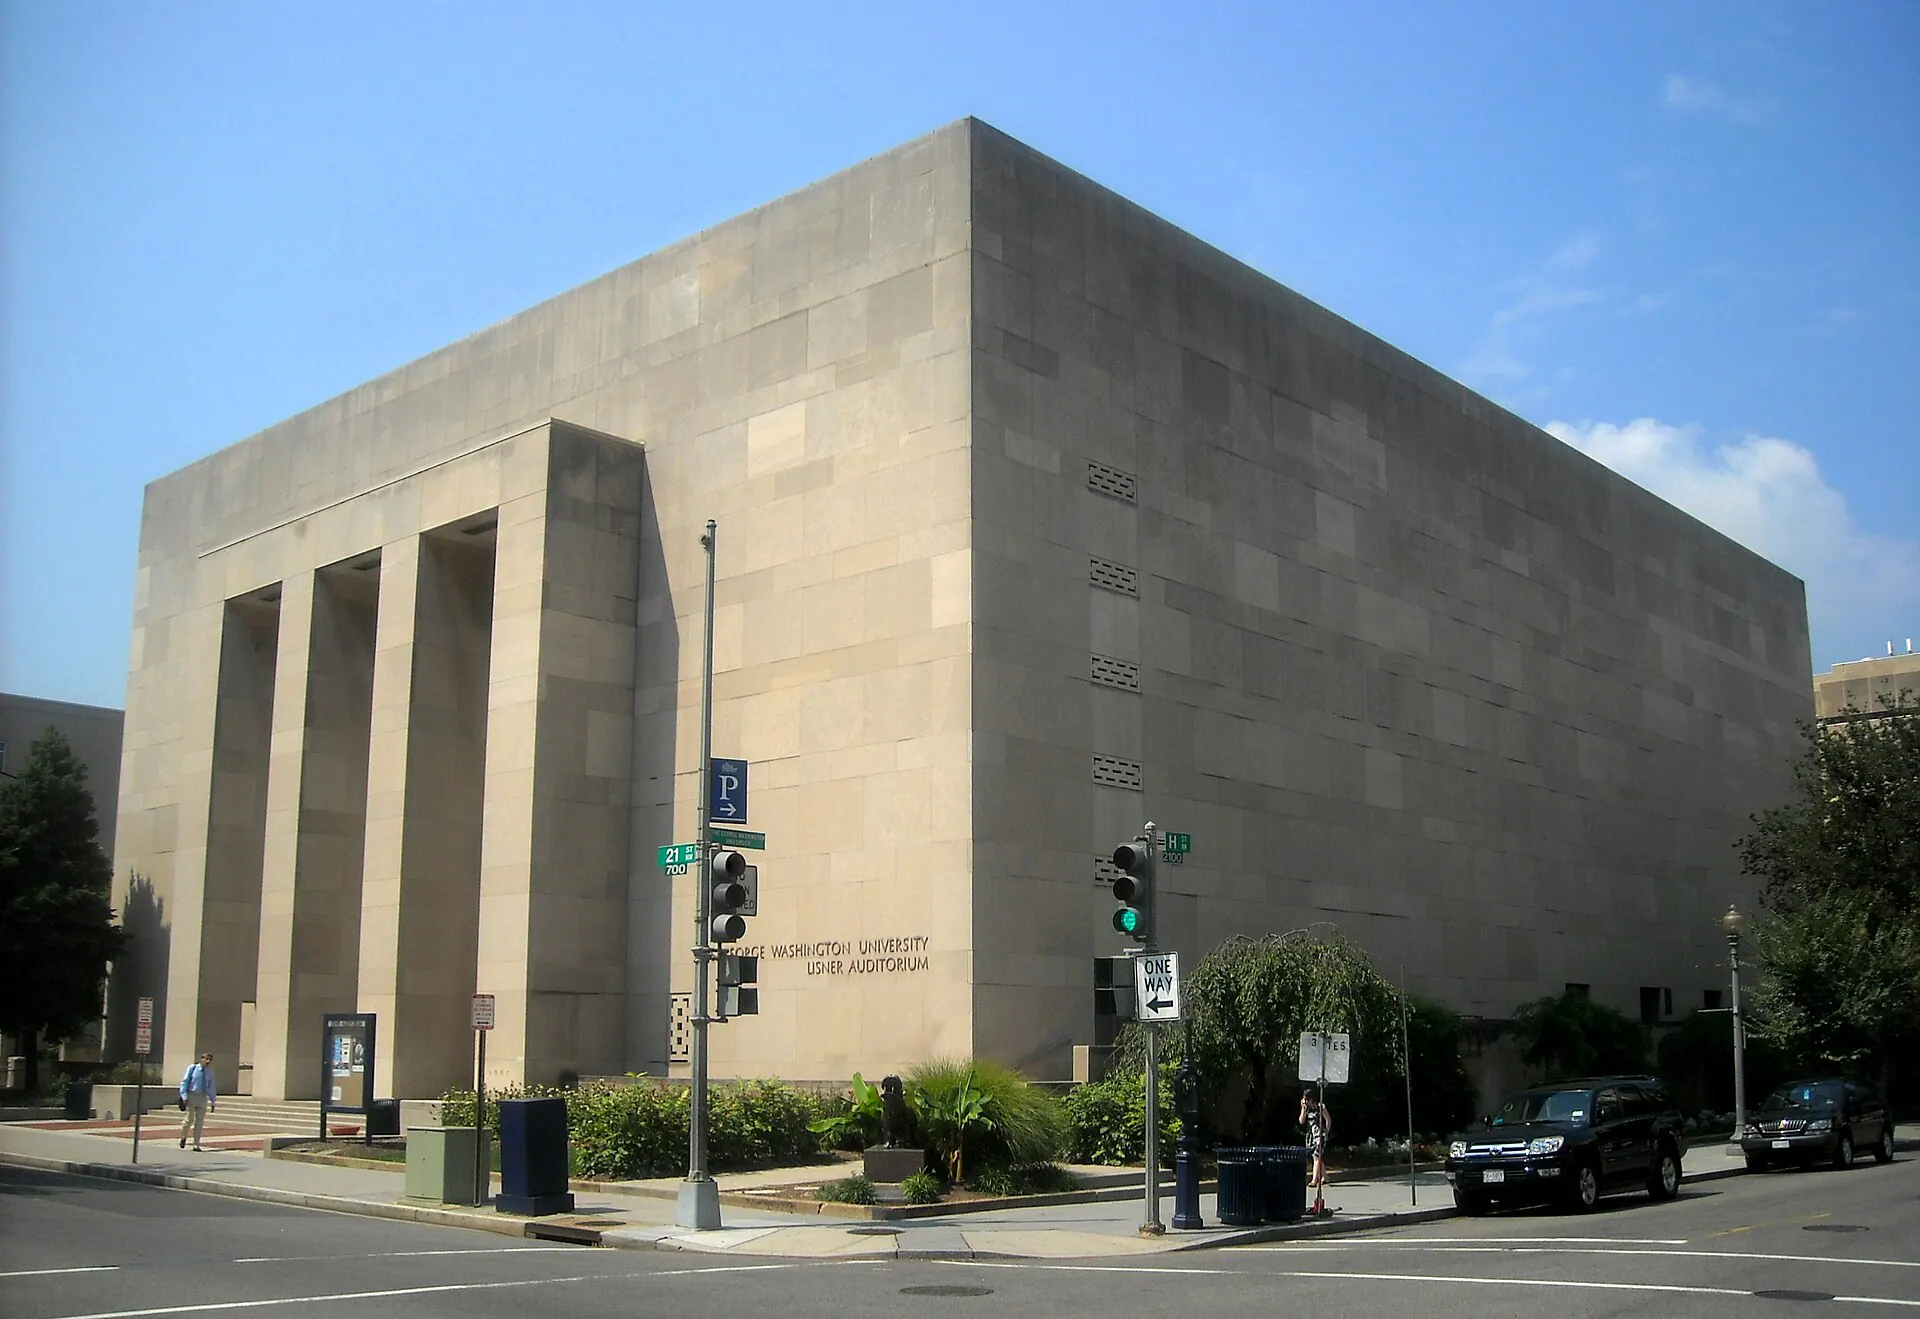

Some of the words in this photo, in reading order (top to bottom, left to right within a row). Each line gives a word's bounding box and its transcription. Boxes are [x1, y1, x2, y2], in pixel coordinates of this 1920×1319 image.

[718, 774, 739, 800] P
[1168, 834, 1177, 850] H
[665, 847, 679, 863] 21
[685, 845, 694, 854] ST
[1163, 852, 1182, 863] 2100
[666, 863, 686, 875] 700
[771, 941, 851, 959] WASHINGTON
[859, 936, 929, 955] UNIVERSITY
[807, 959, 844, 976] LISNER
[848, 956, 929, 975] AUDITORIUM
[1144, 959, 1172, 975] ONE
[1144, 976, 1173, 992] WAY
